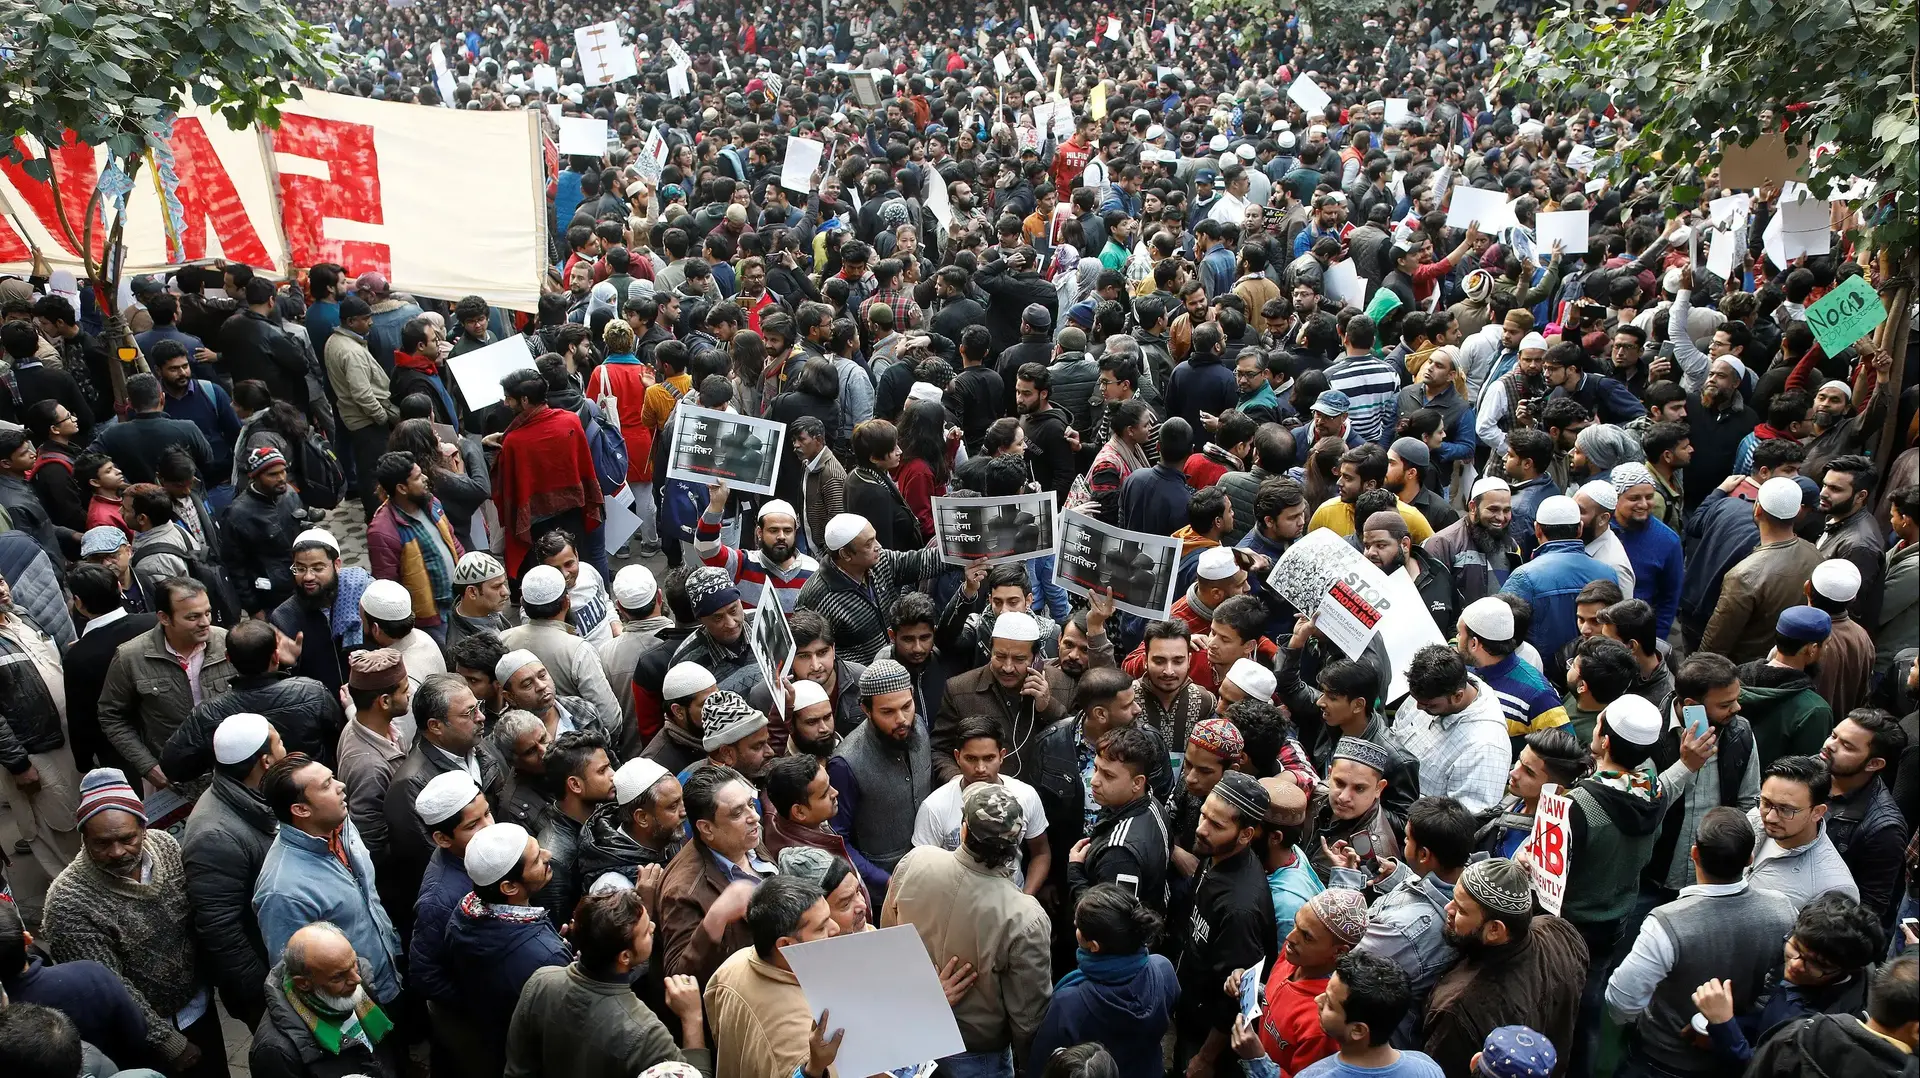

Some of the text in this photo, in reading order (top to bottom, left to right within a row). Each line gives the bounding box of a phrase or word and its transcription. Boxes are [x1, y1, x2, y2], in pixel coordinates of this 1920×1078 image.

[1330, 588, 1374, 628] PROFILING
[1336, 580, 1382, 621] RELIGIOUS
[1345, 572, 1391, 610] STOP
[1325, 603, 1345, 622] PROTEST
[1344, 620, 1364, 638] AGAINST
[1525, 815, 1564, 876] AB
